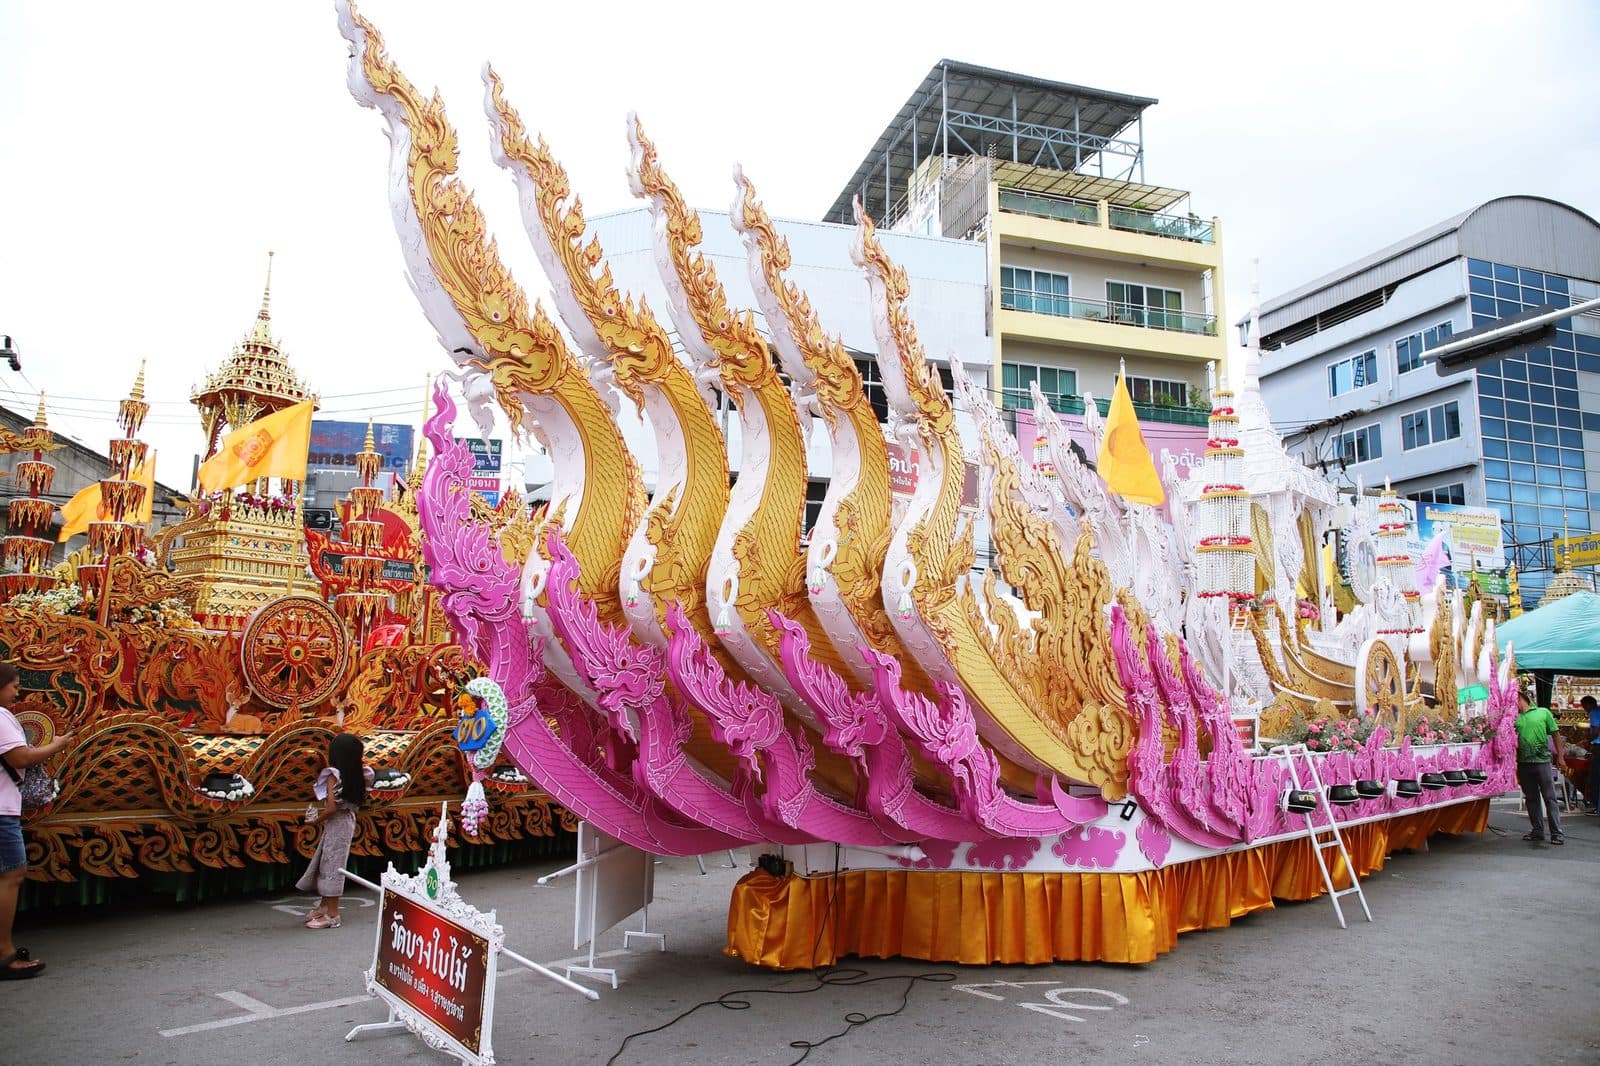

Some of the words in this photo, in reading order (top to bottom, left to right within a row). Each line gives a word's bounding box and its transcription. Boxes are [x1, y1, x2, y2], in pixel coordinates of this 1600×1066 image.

[390, 911, 473, 993] วัดบางใบไม้
